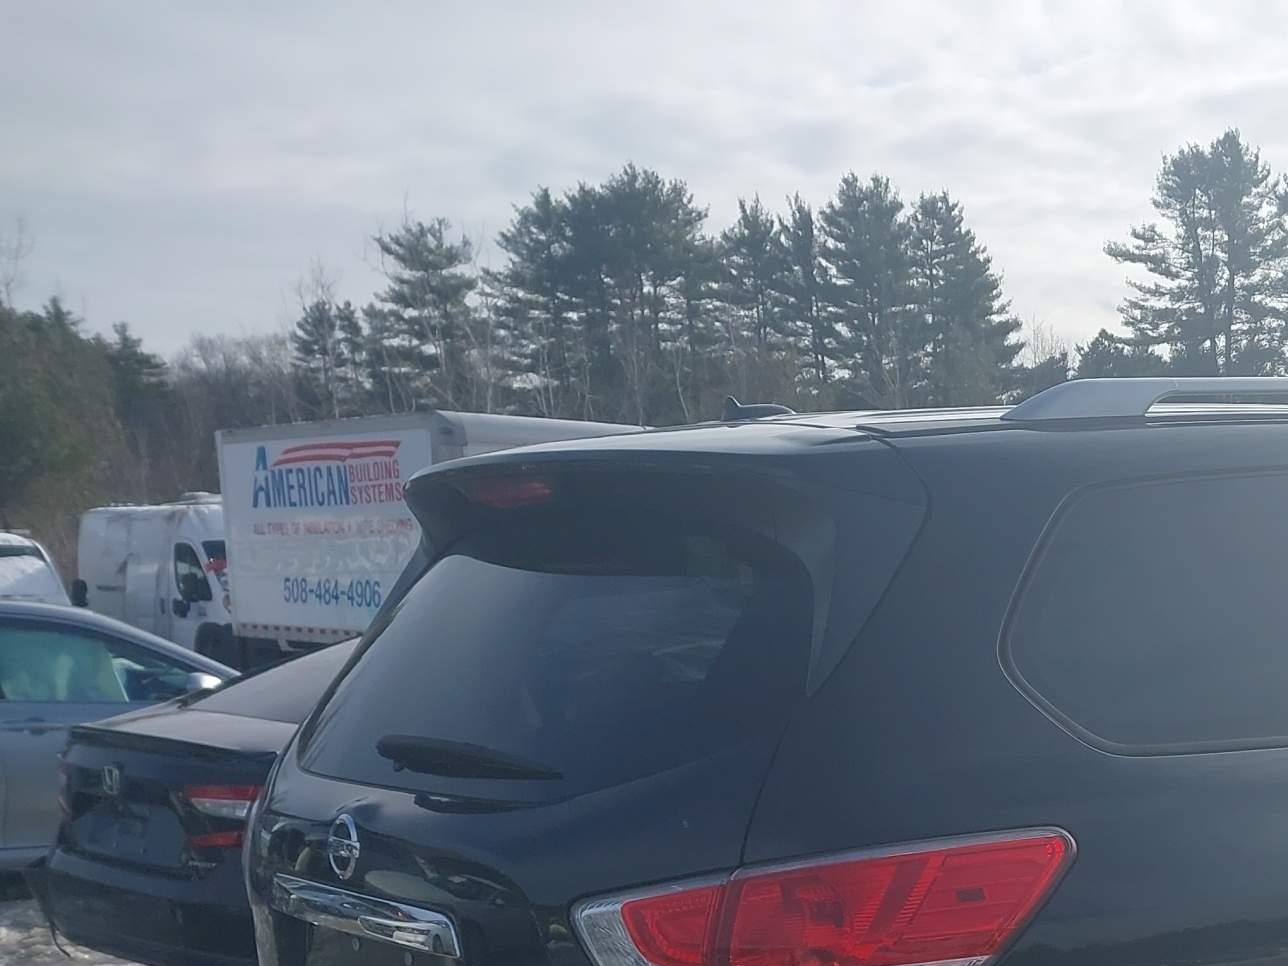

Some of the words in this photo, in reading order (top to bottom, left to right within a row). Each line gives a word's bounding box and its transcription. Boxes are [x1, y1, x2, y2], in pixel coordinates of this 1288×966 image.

[252, 445, 350, 508] AMERICAN
[350, 460, 400, 483] BUILDING
[351, 482, 402, 505] SYSTEMS
[284, 577, 382, 609] 508-484-4906
